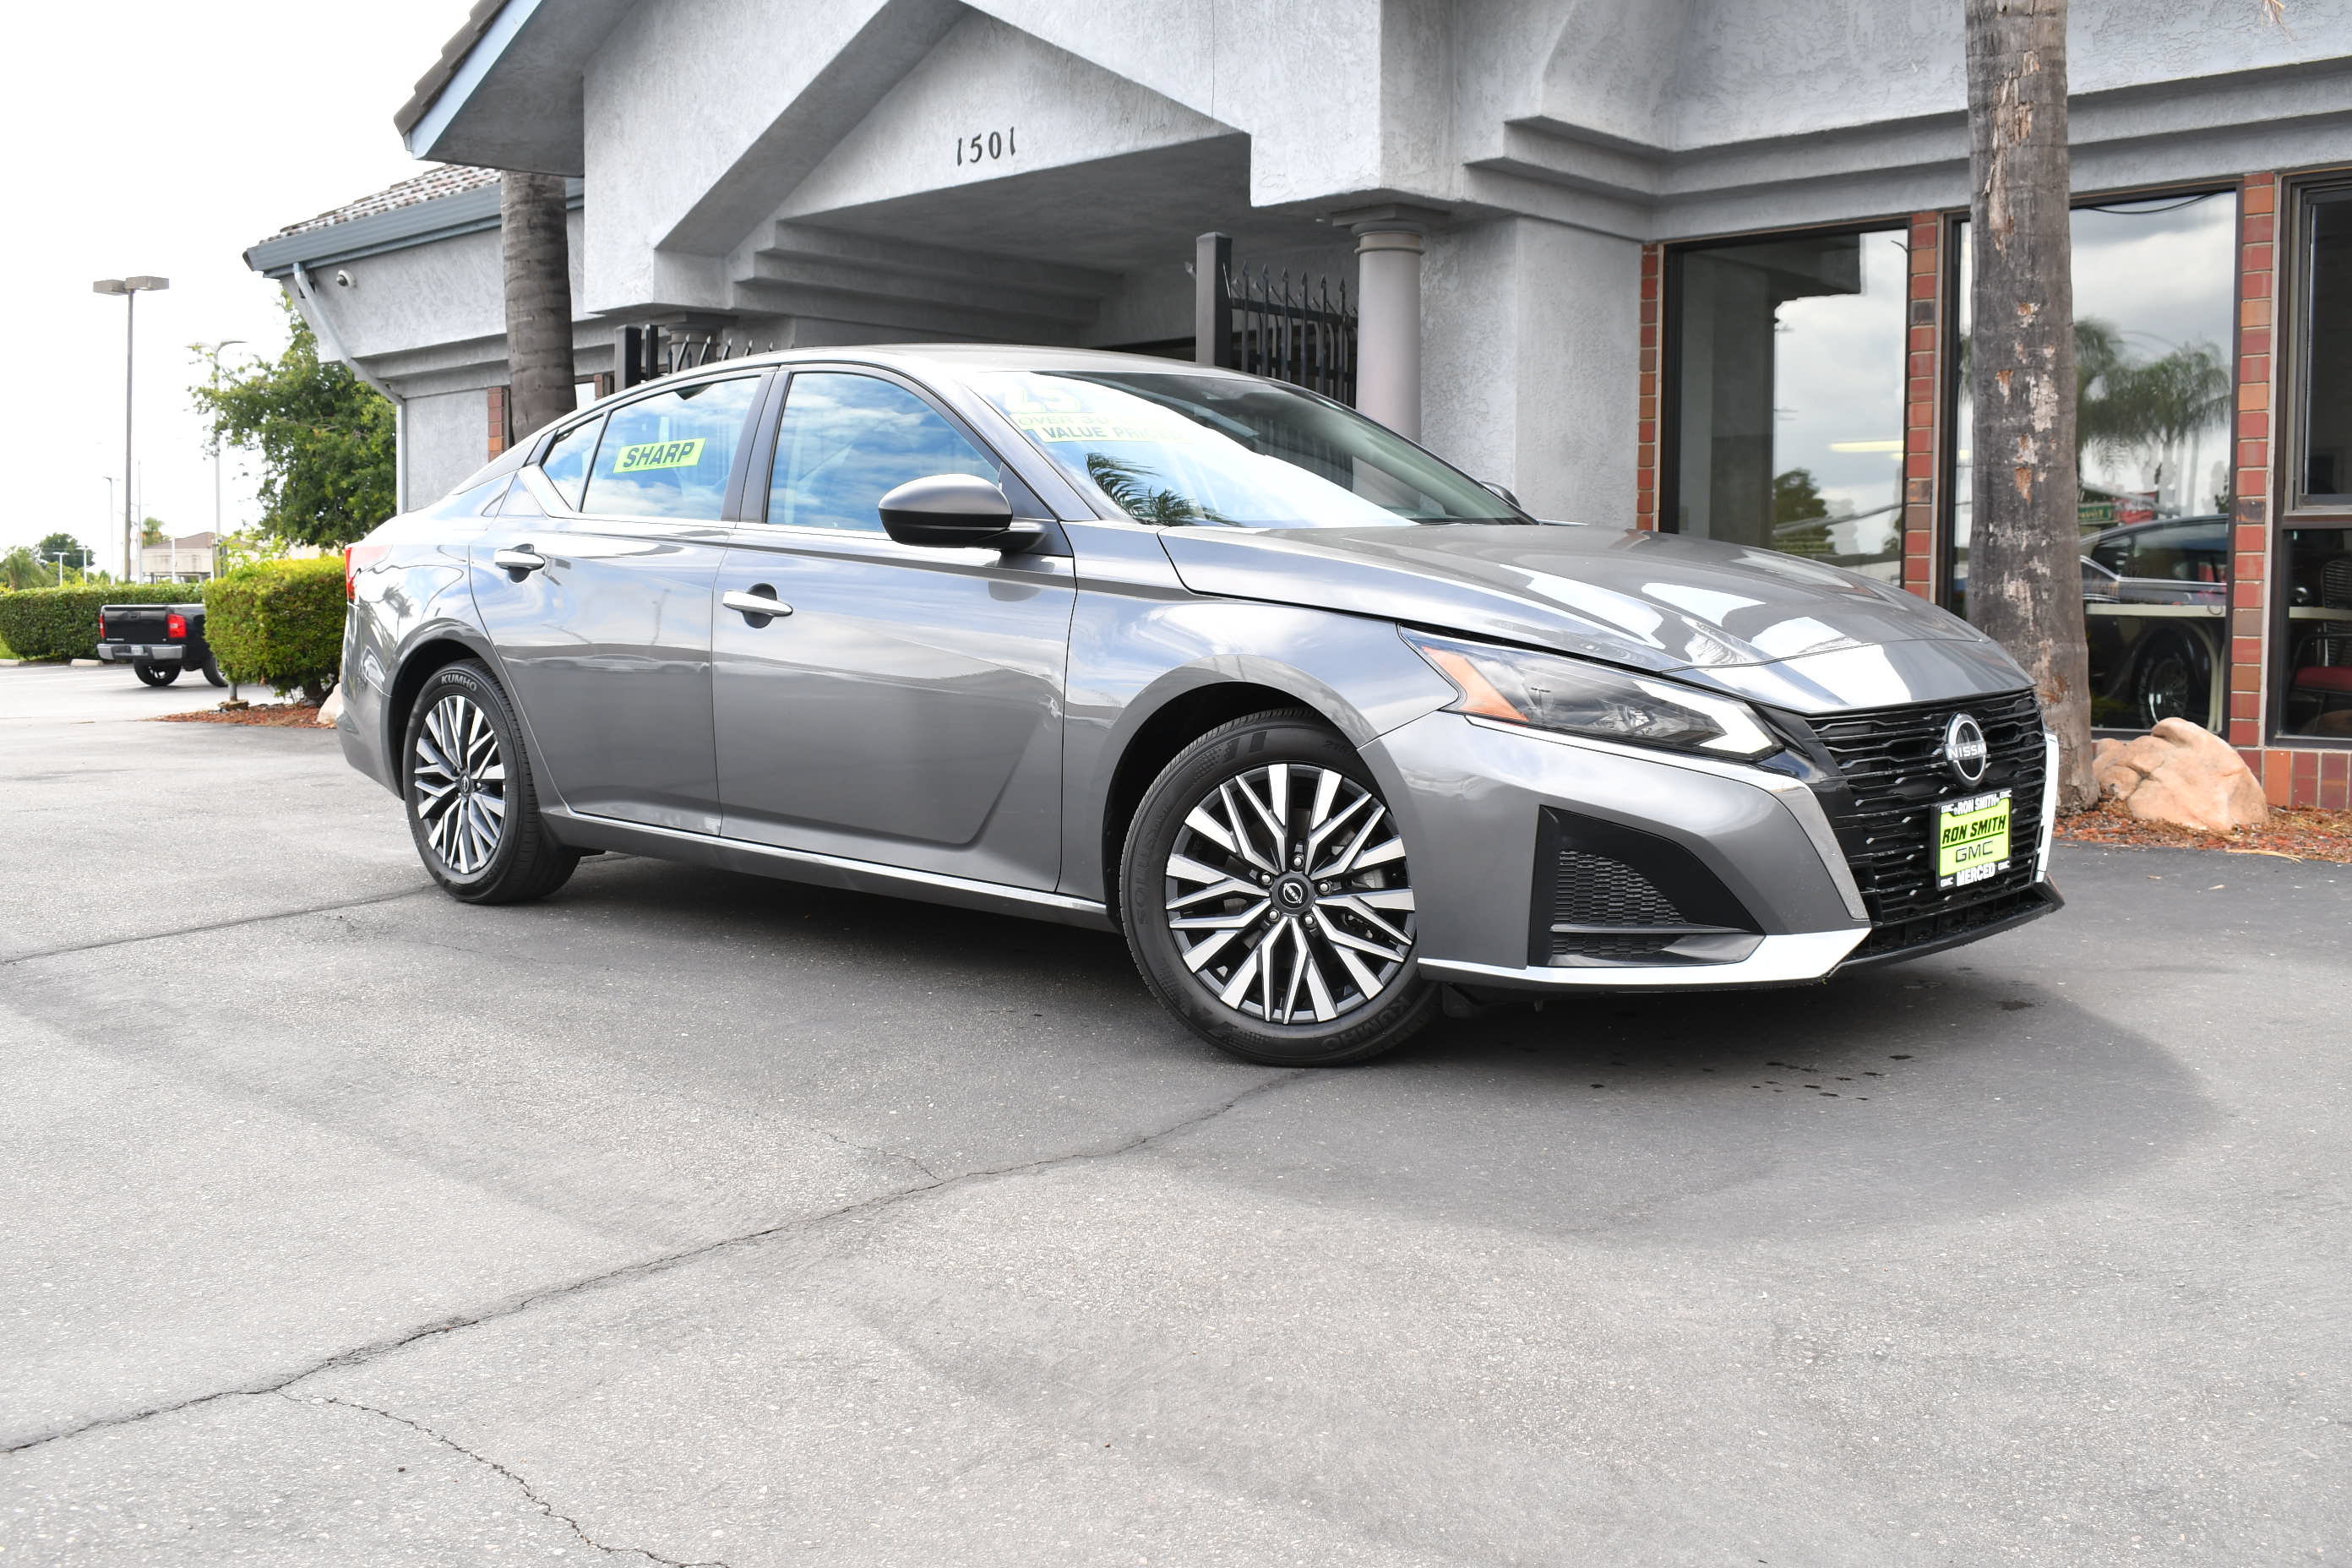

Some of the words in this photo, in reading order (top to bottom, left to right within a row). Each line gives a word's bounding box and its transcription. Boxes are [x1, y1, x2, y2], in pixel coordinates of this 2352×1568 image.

[956, 126, 1016, 166] 1501
[1042, 427, 1108, 438] VALUE
[622, 441, 695, 468] SHARP
[441, 673, 477, 693] KUMHO
[1947, 744, 1987, 760] NISSAN
[1941, 824, 1968, 845] RON
[1970, 814, 2006, 838] SMITH
[1955, 840, 1994, 863] GMC
[1956, 862, 1996, 887] MERCED
